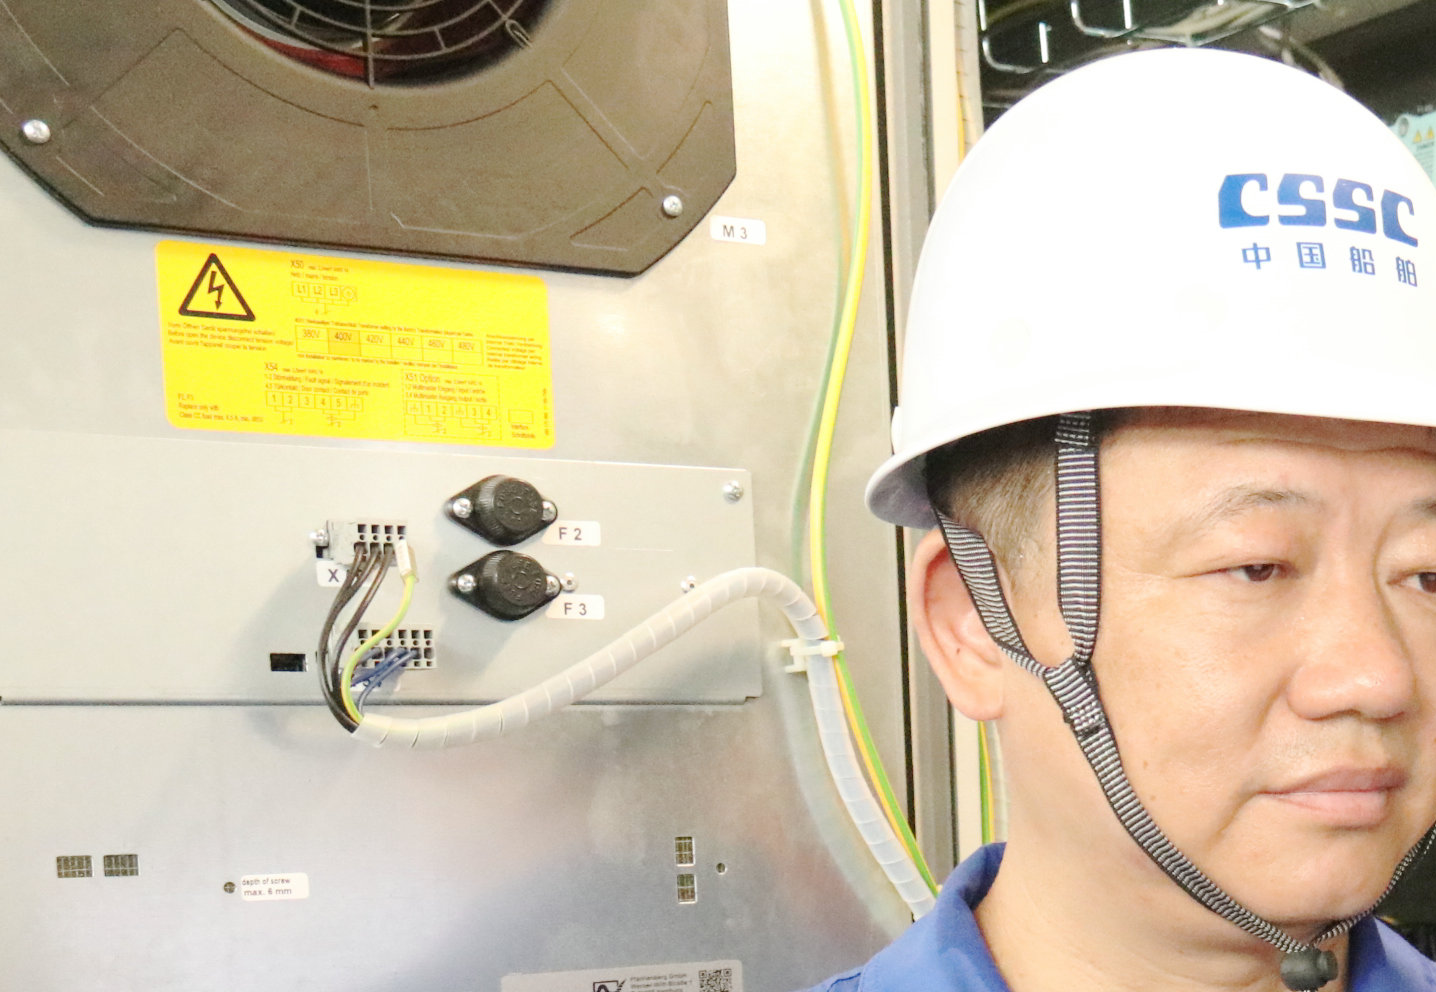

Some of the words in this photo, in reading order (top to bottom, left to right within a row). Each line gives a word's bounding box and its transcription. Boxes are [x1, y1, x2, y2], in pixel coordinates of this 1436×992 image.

[1218, 173, 1418, 247] CSSC
[722, 224, 735, 238] M
[740, 226, 748, 240] 3
[1241, 242, 1418, 287] 中国船舶
[313, 286, 322, 295] L2
[329, 287, 338, 296] L3
[334, 332, 352, 341] 400V
[366, 335, 384, 344] 420V
[419, 374, 440, 384] Option
[558, 528, 568, 540] F
[573, 528, 582, 541] 2
[563, 603, 573, 615] F
[578, 603, 587, 616] 3
[262, 877, 269, 885] of
